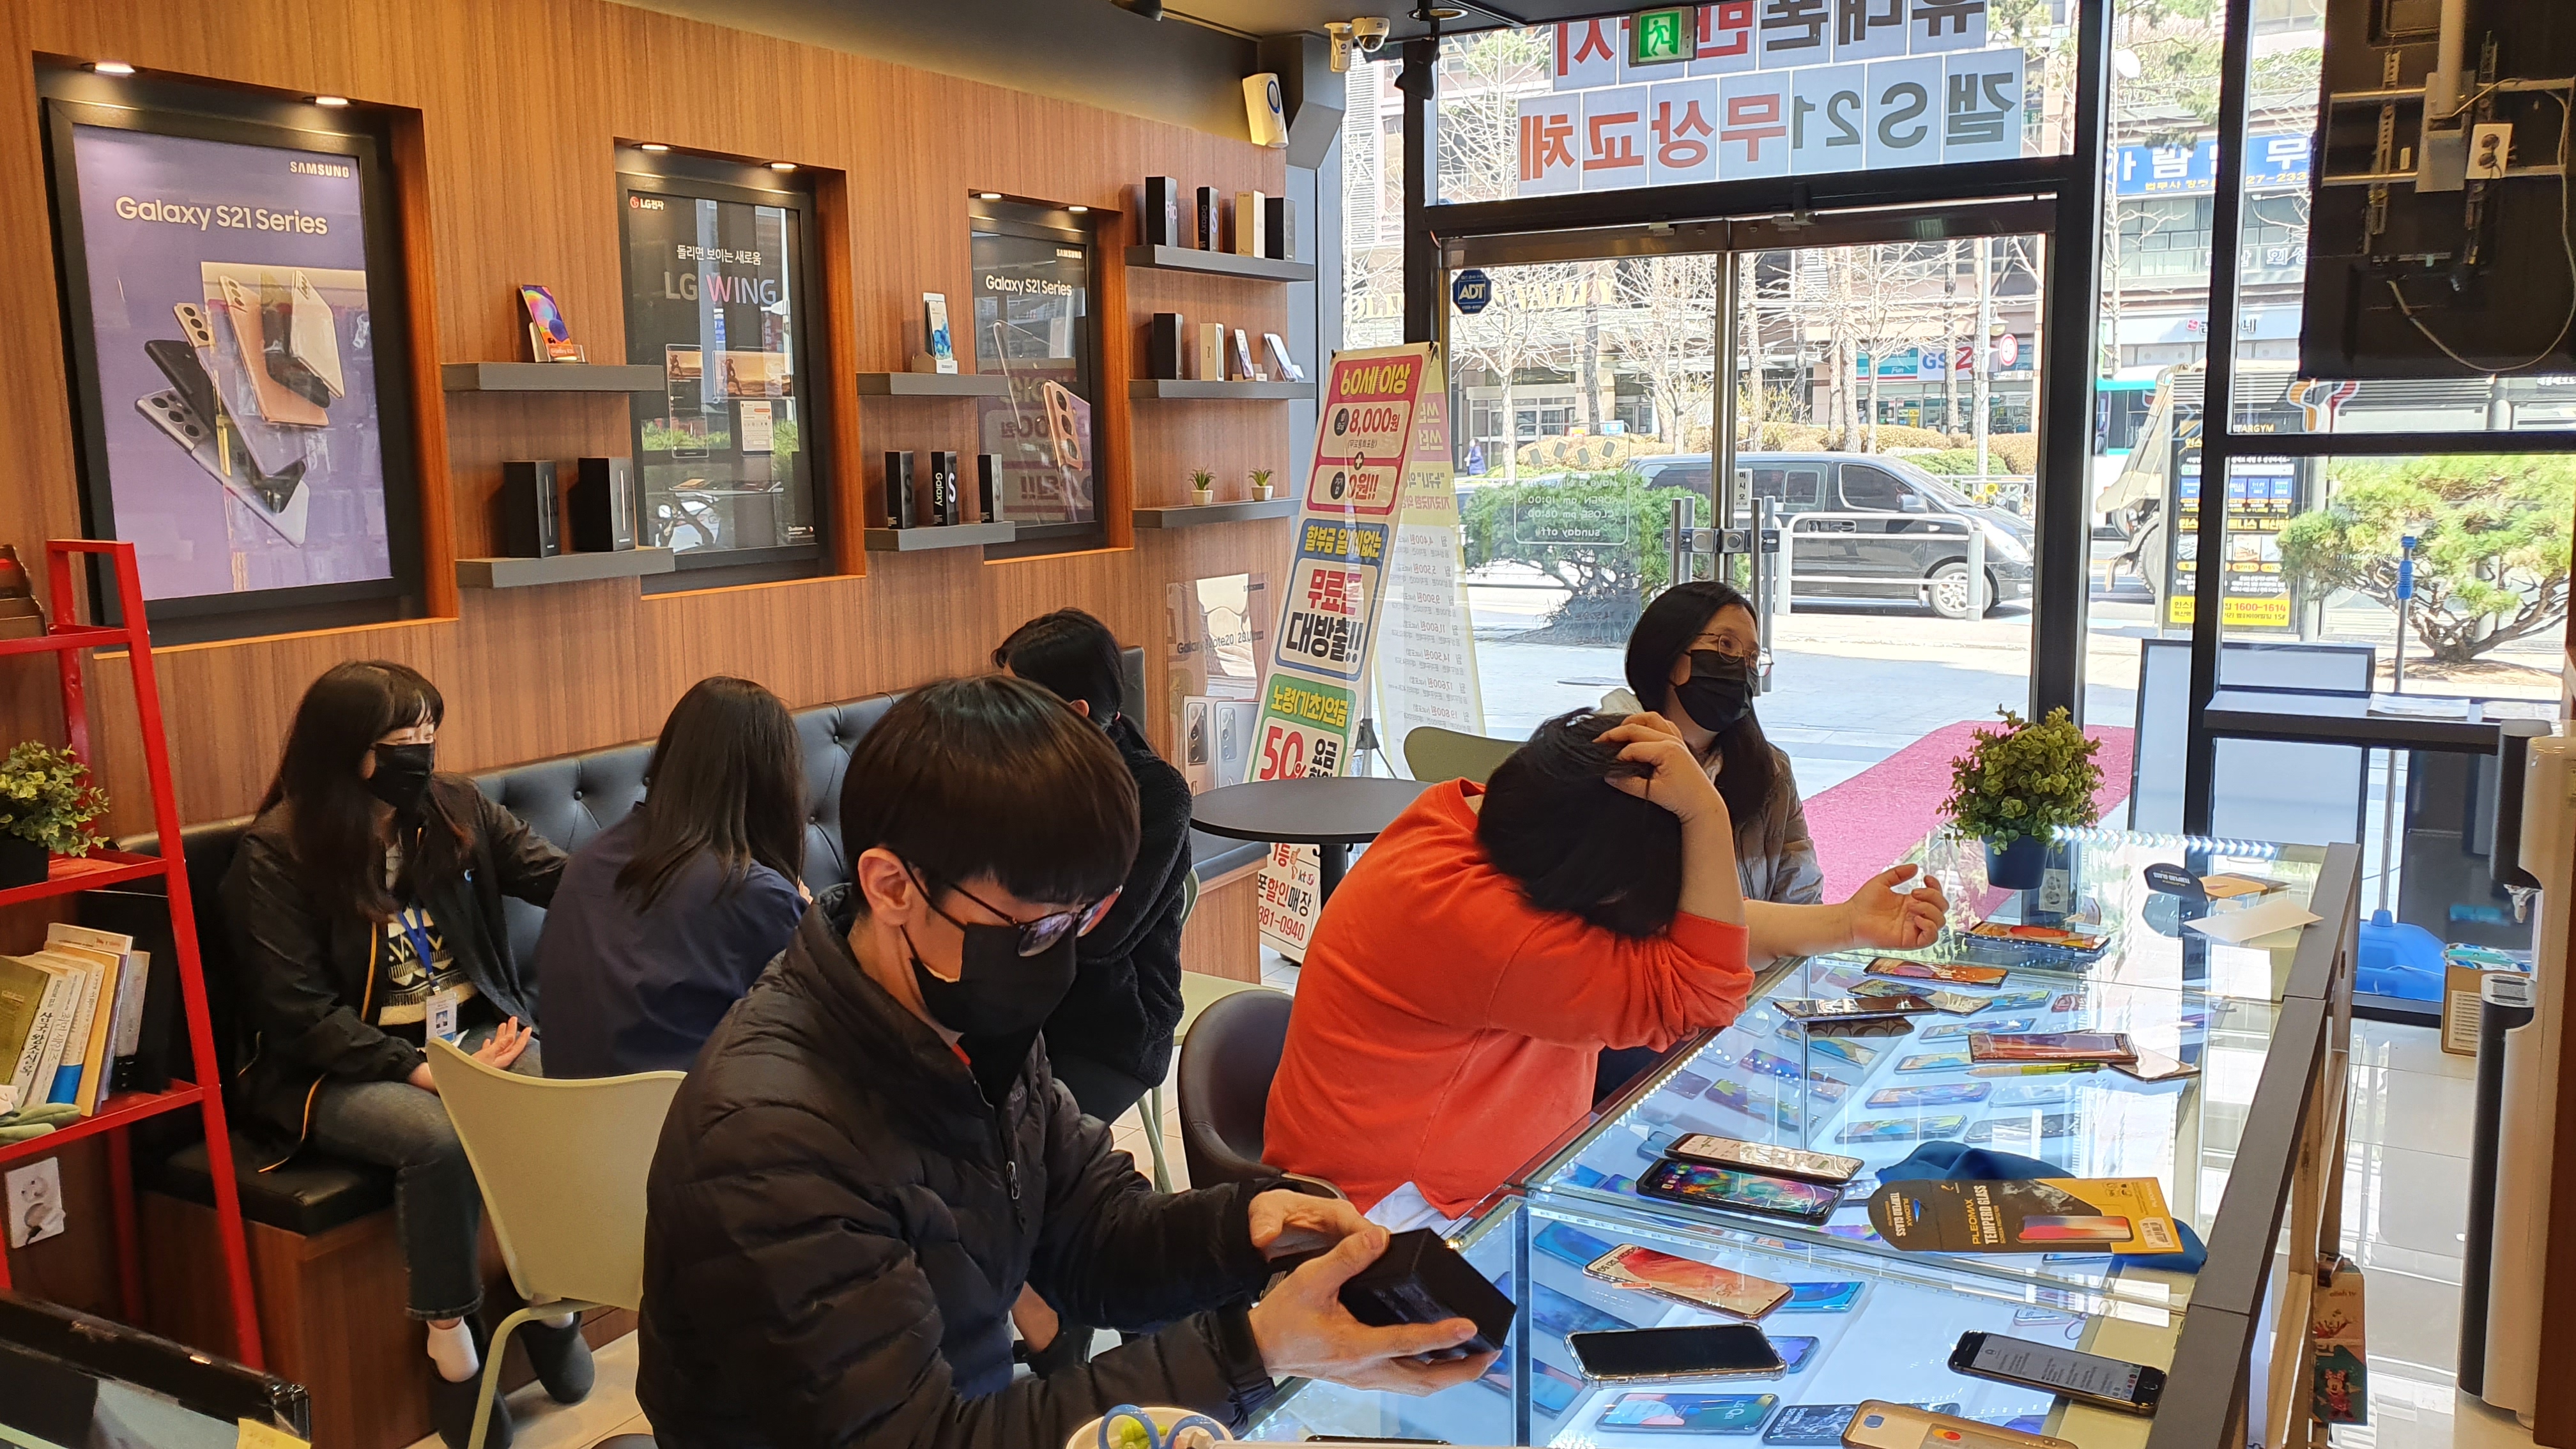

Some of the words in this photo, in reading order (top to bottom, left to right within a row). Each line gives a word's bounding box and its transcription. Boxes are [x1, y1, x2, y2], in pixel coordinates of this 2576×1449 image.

[289, 161, 350, 179] SAMSUNG
[115, 196, 211, 231] Galaxy
[216, 205, 252, 229] S21
[256, 209, 328, 234] Series
[677, 245, 705, 261] 돌리면
[706, 248, 733, 263] 보이는
[735, 250, 762, 266] 새로움
[1056, 249, 1082, 259] SAMSUNG
[664, 272, 698, 301] LG
[705, 275, 776, 305] WING
[986, 275, 1024, 296] Galaxy
[1025, 279, 1041, 294] S21
[1041, 280, 1073, 296] Series
[1459, 284, 1485, 299] ADT
[1922, 346, 1975, 375] GS2
[1340, 366, 1379, 395] 60세
[1379, 363, 1411, 394] 이상
[1349, 408, 1400, 436] 8,000원
[935, 472, 944, 507] Galaxy
[948, 472, 956, 503] S
[1304, 525, 1337, 554] 할부금
[1286, 611, 1364, 663] 대방출!!
[1271, 685, 1349, 727] 노령(기초)연금
[1312, 738, 1337, 770] 요금
[1273, 843, 1291, 867] 1등
[1298, 870, 1307, 883] kt
[1890, 1192, 1903, 1216] TEMPERD
[1974, 1185, 1991, 1206] GLASS
[1894, 1216, 1906, 1237] GLASS
[1902, 1198, 1913, 1227] PLEOMAX
[1965, 1199, 1981, 1245] PLEOMAX
[1979, 1205, 1998, 1245] TEMPERD
